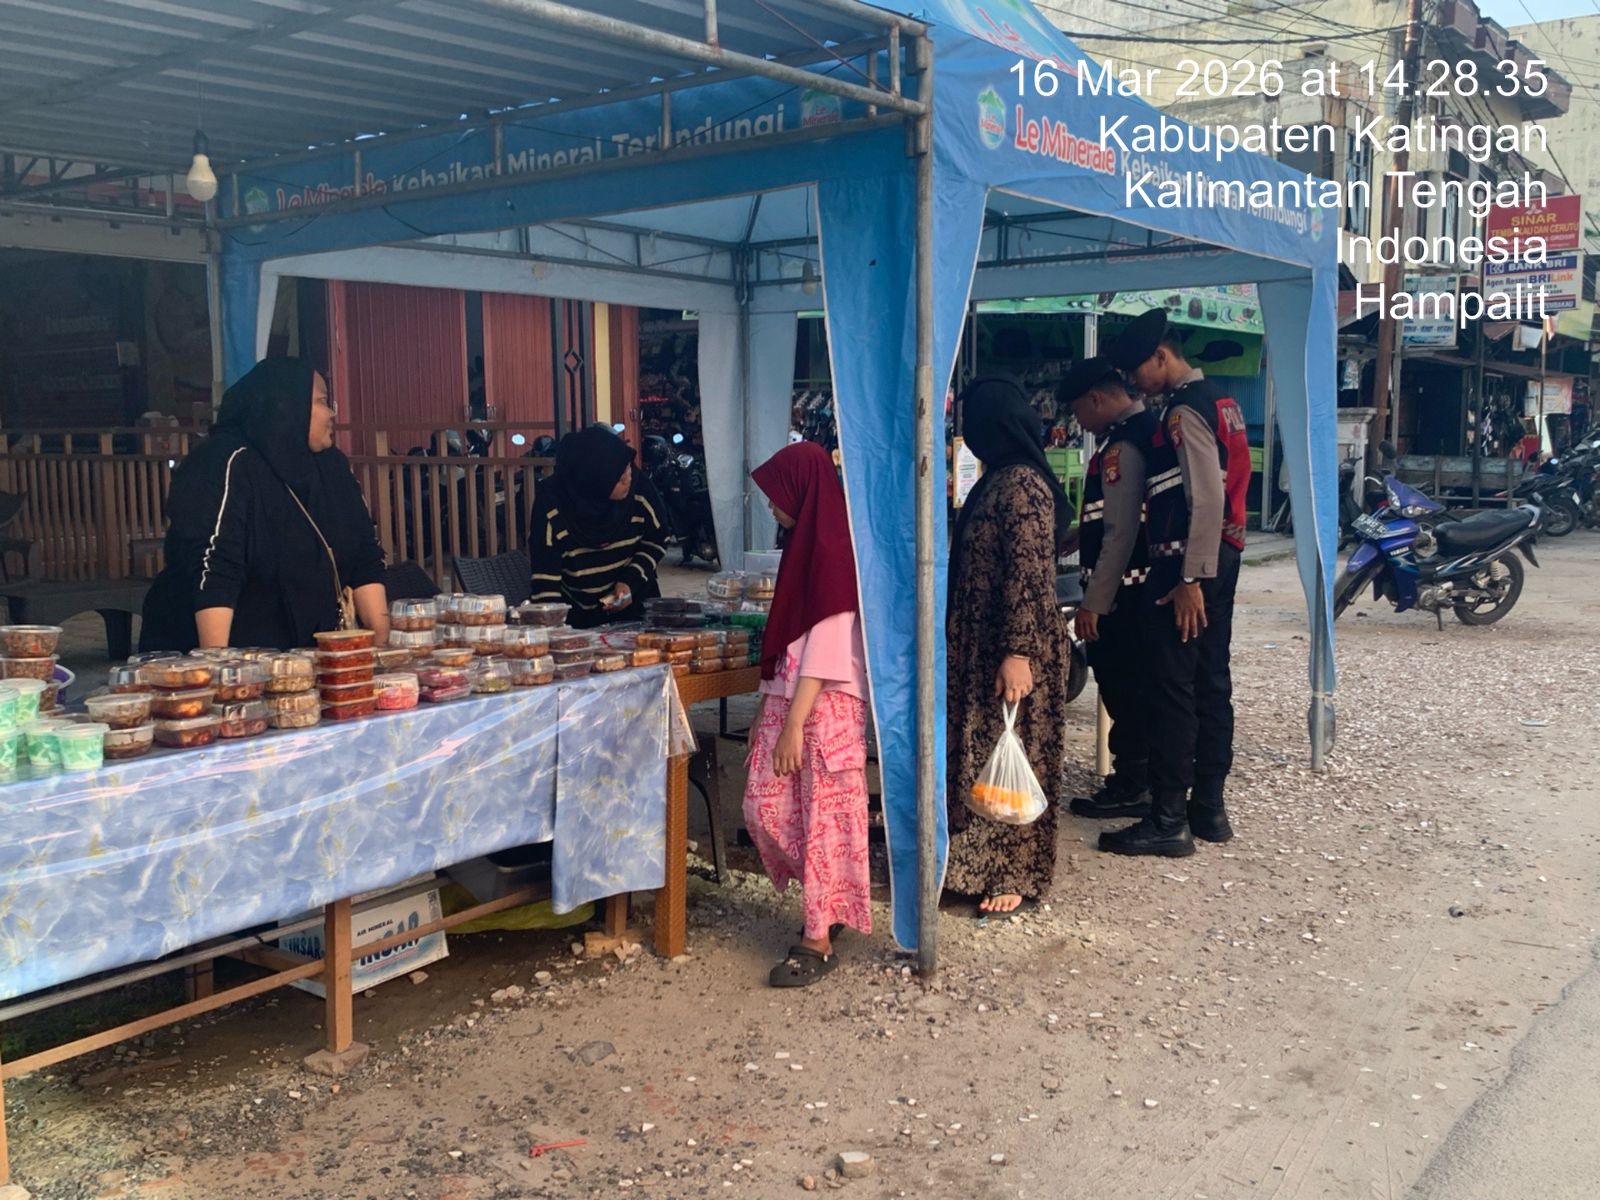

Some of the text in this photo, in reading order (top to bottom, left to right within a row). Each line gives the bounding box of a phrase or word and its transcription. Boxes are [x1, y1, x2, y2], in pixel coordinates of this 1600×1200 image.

[1015, 104, 1040, 152] Le
[507, 136, 601, 175] Mineral
[611, 103, 784, 158] Terlndungi
[1511, 212, 1557, 227] SINAR
[1491, 225, 1533, 239] TEMBKAU
[1508, 258, 1568, 272] BANK BRI
[356, 918, 394, 937] AIR MINERAL
